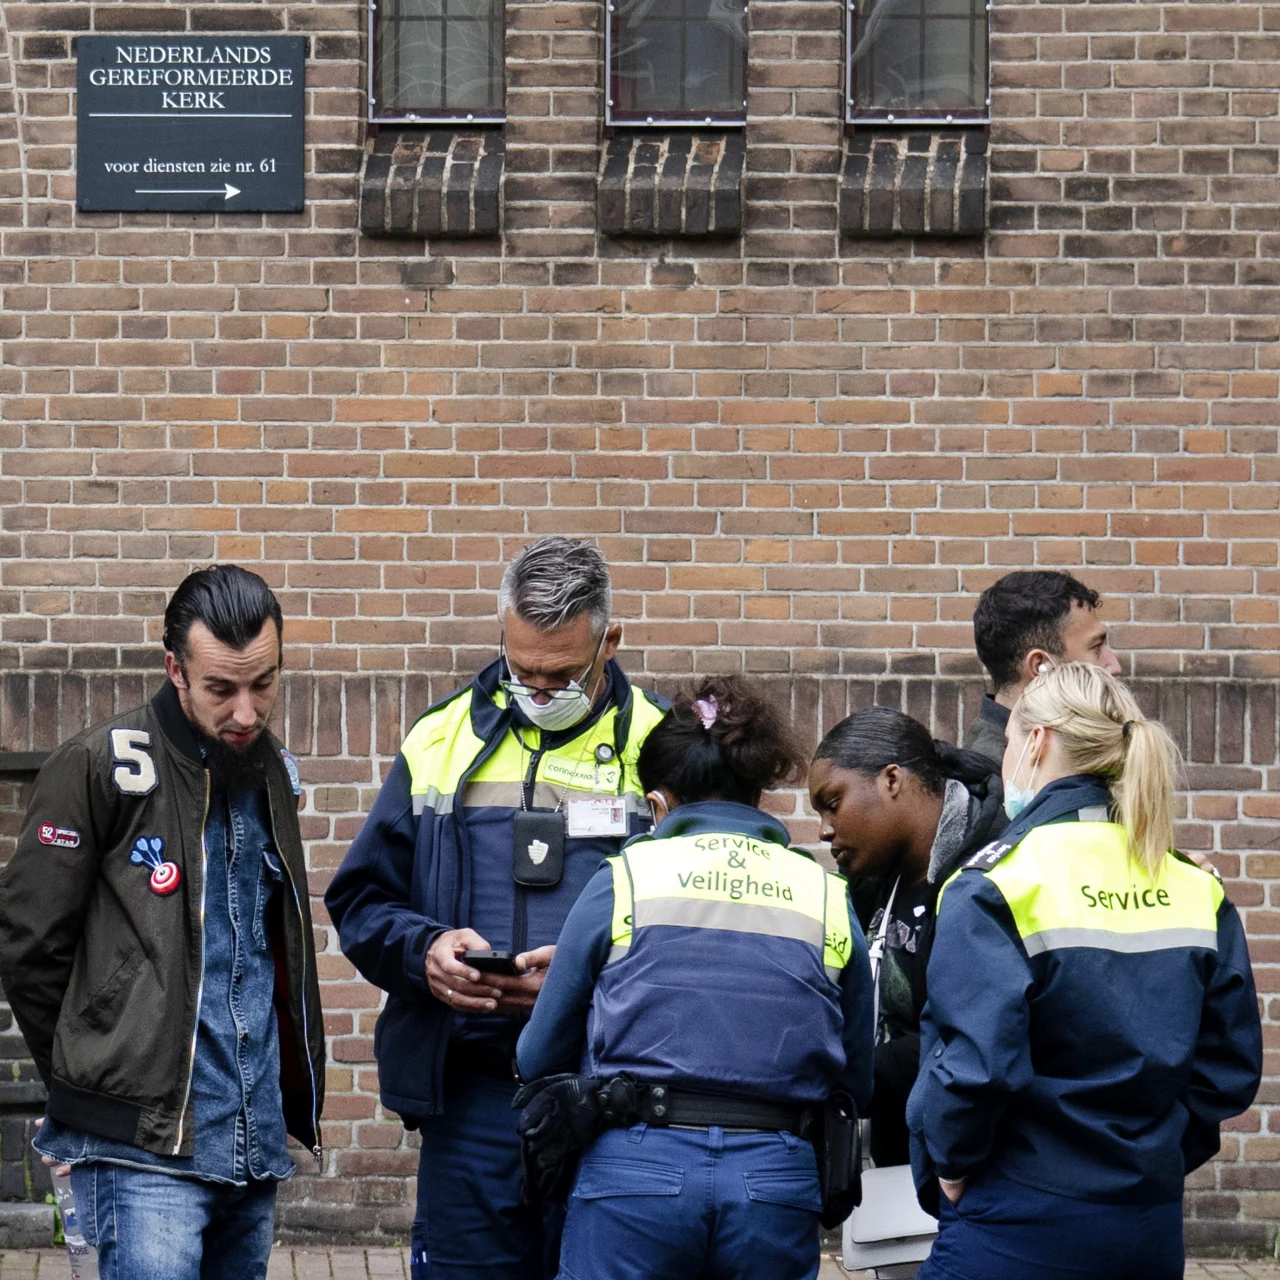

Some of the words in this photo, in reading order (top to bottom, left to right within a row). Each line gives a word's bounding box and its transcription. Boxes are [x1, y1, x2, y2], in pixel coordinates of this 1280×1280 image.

[116, 46, 271, 64] NEDERLANDS
[89, 69, 293, 86] GEREFORMEERDE
[161, 91, 225, 109] KERK
[104, 162, 139, 173] voor
[143, 158, 205, 173] diensten
[210, 159, 231, 173] zie
[235, 162, 255, 173] nr.
[259, 158, 277, 173] 61
[110, 728, 158, 796] 5
[42, 826, 53, 838] 52
[727, 851, 747, 869] &
[677, 871, 793, 901] Veiligheid
[1081, 884, 1171, 911] Service
